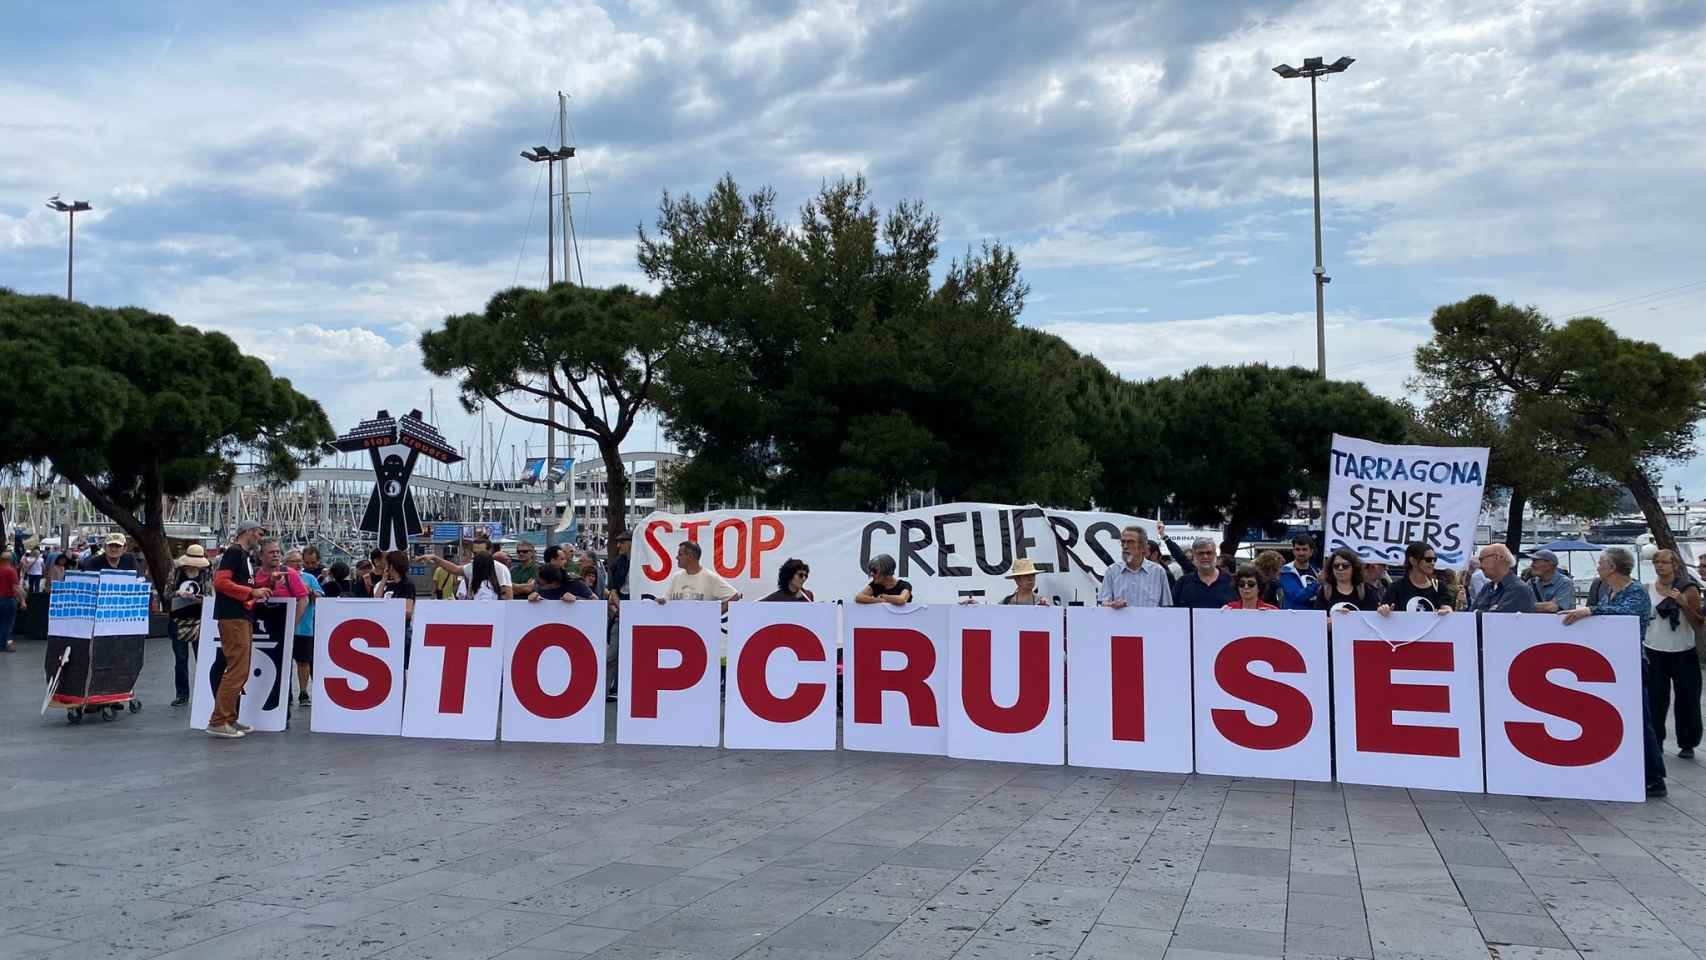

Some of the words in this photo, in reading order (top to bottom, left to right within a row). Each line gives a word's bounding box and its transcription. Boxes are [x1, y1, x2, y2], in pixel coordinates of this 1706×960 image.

[1332, 449, 1483, 487] TARRAGONA
[1350, 484, 1443, 520] SENSE
[640, 515, 785, 582] STOP
[859, 508, 1121, 583] CREUERS
[1331, 511, 1461, 551] CREUERS
